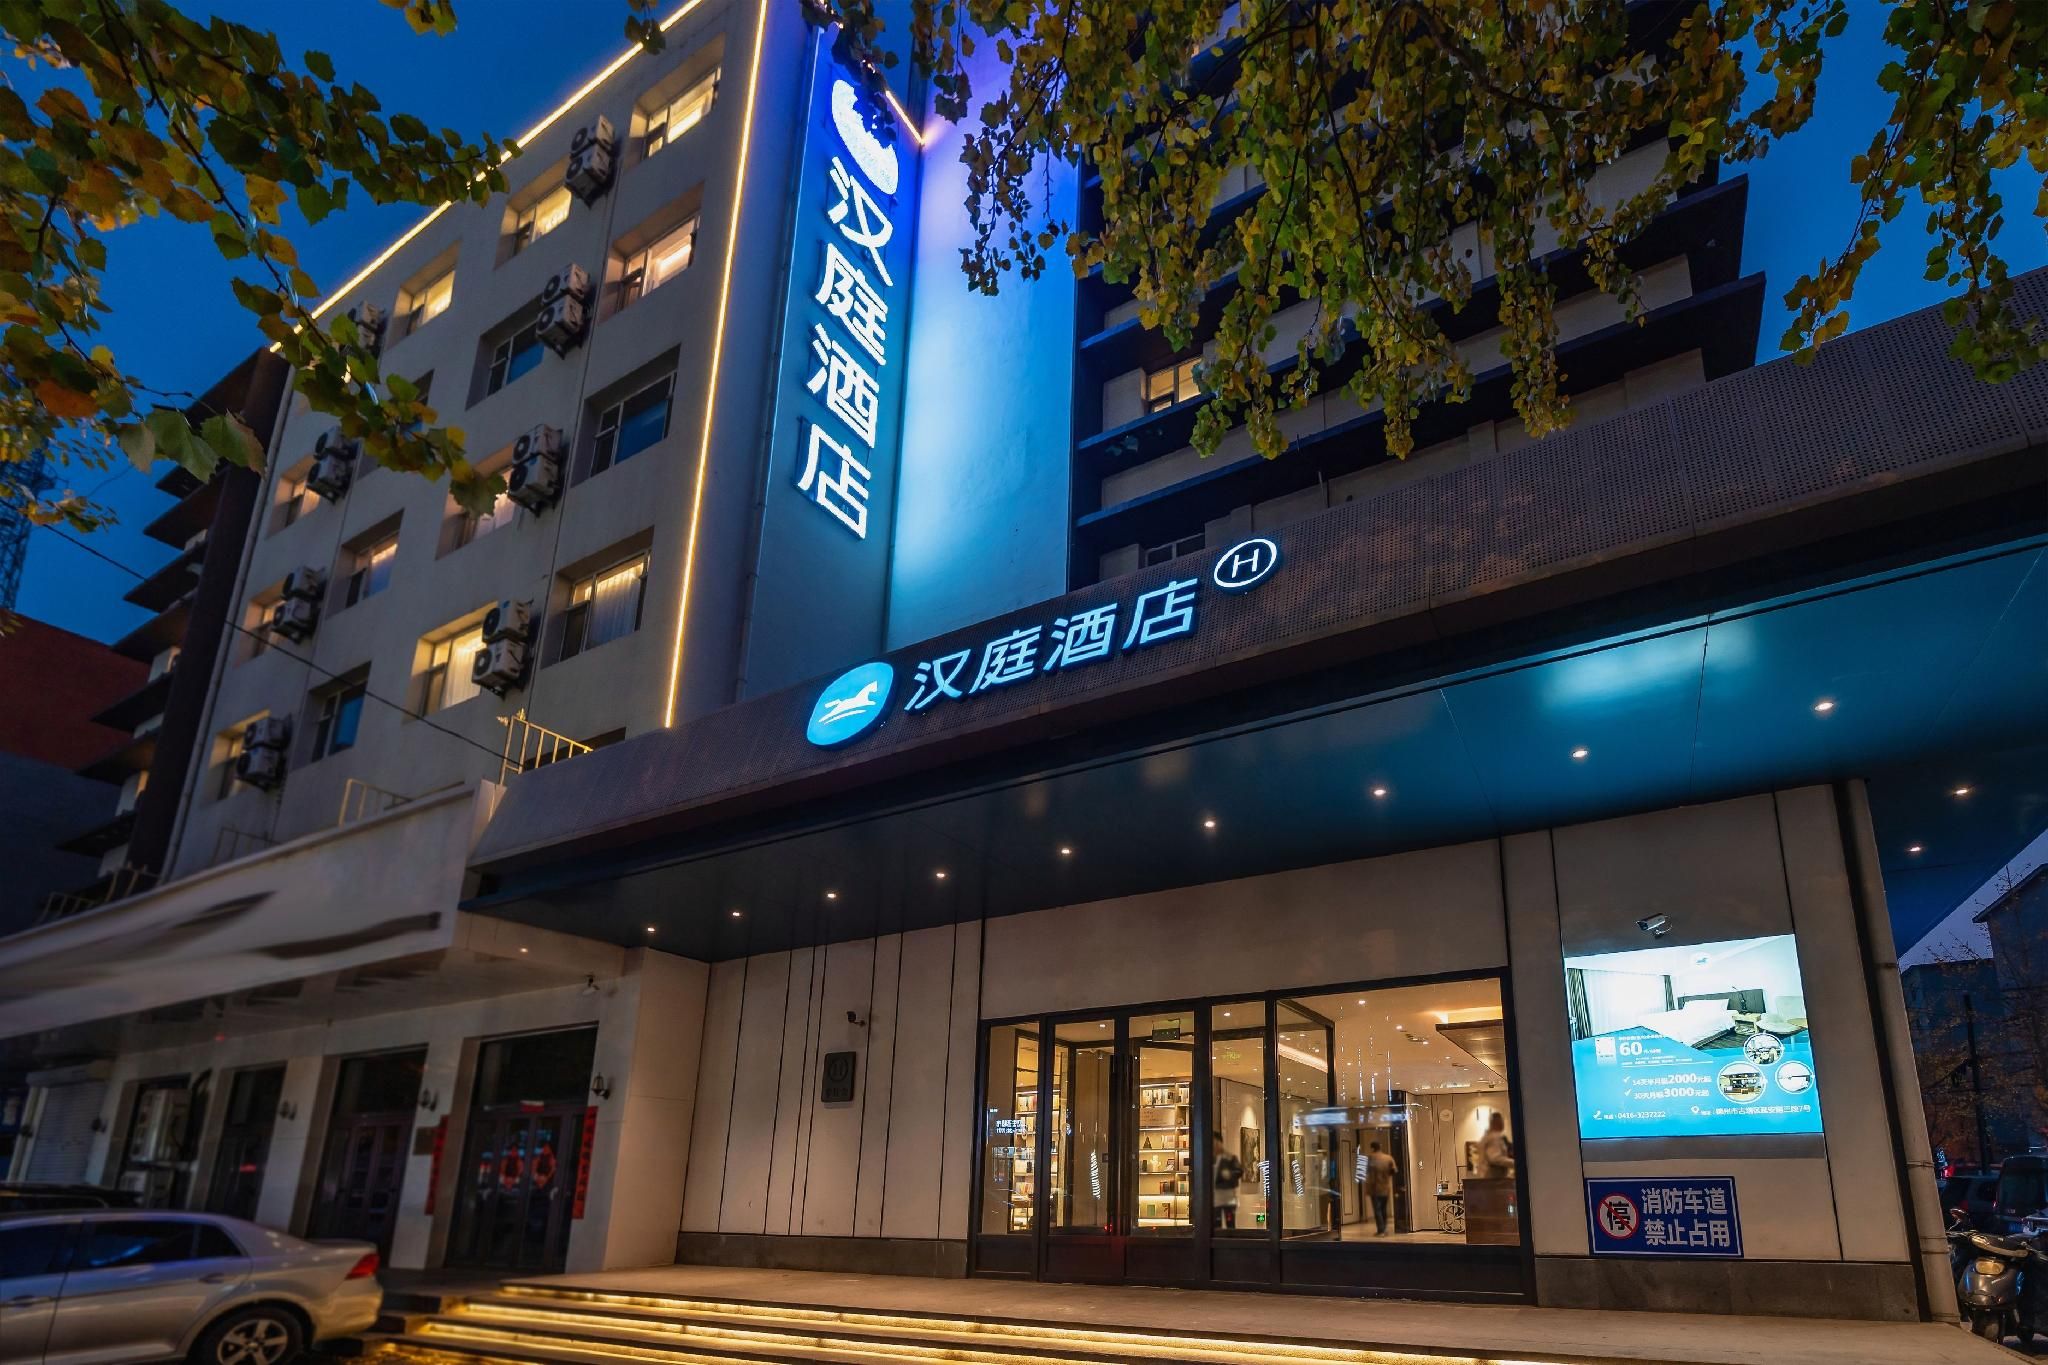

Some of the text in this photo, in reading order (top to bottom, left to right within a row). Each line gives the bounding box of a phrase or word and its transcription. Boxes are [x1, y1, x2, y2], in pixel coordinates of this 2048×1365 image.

[799, 156, 893, 539] 汉庭酒店
[1231, 548, 1261, 580] H
[904, 576, 1199, 712] 汉庭酒店
[1619, 1041, 1643, 1056] 60
[1641, 1187, 1728, 1215] 消防车道
[1644, 1218, 1731, 1247] 禁止占用
